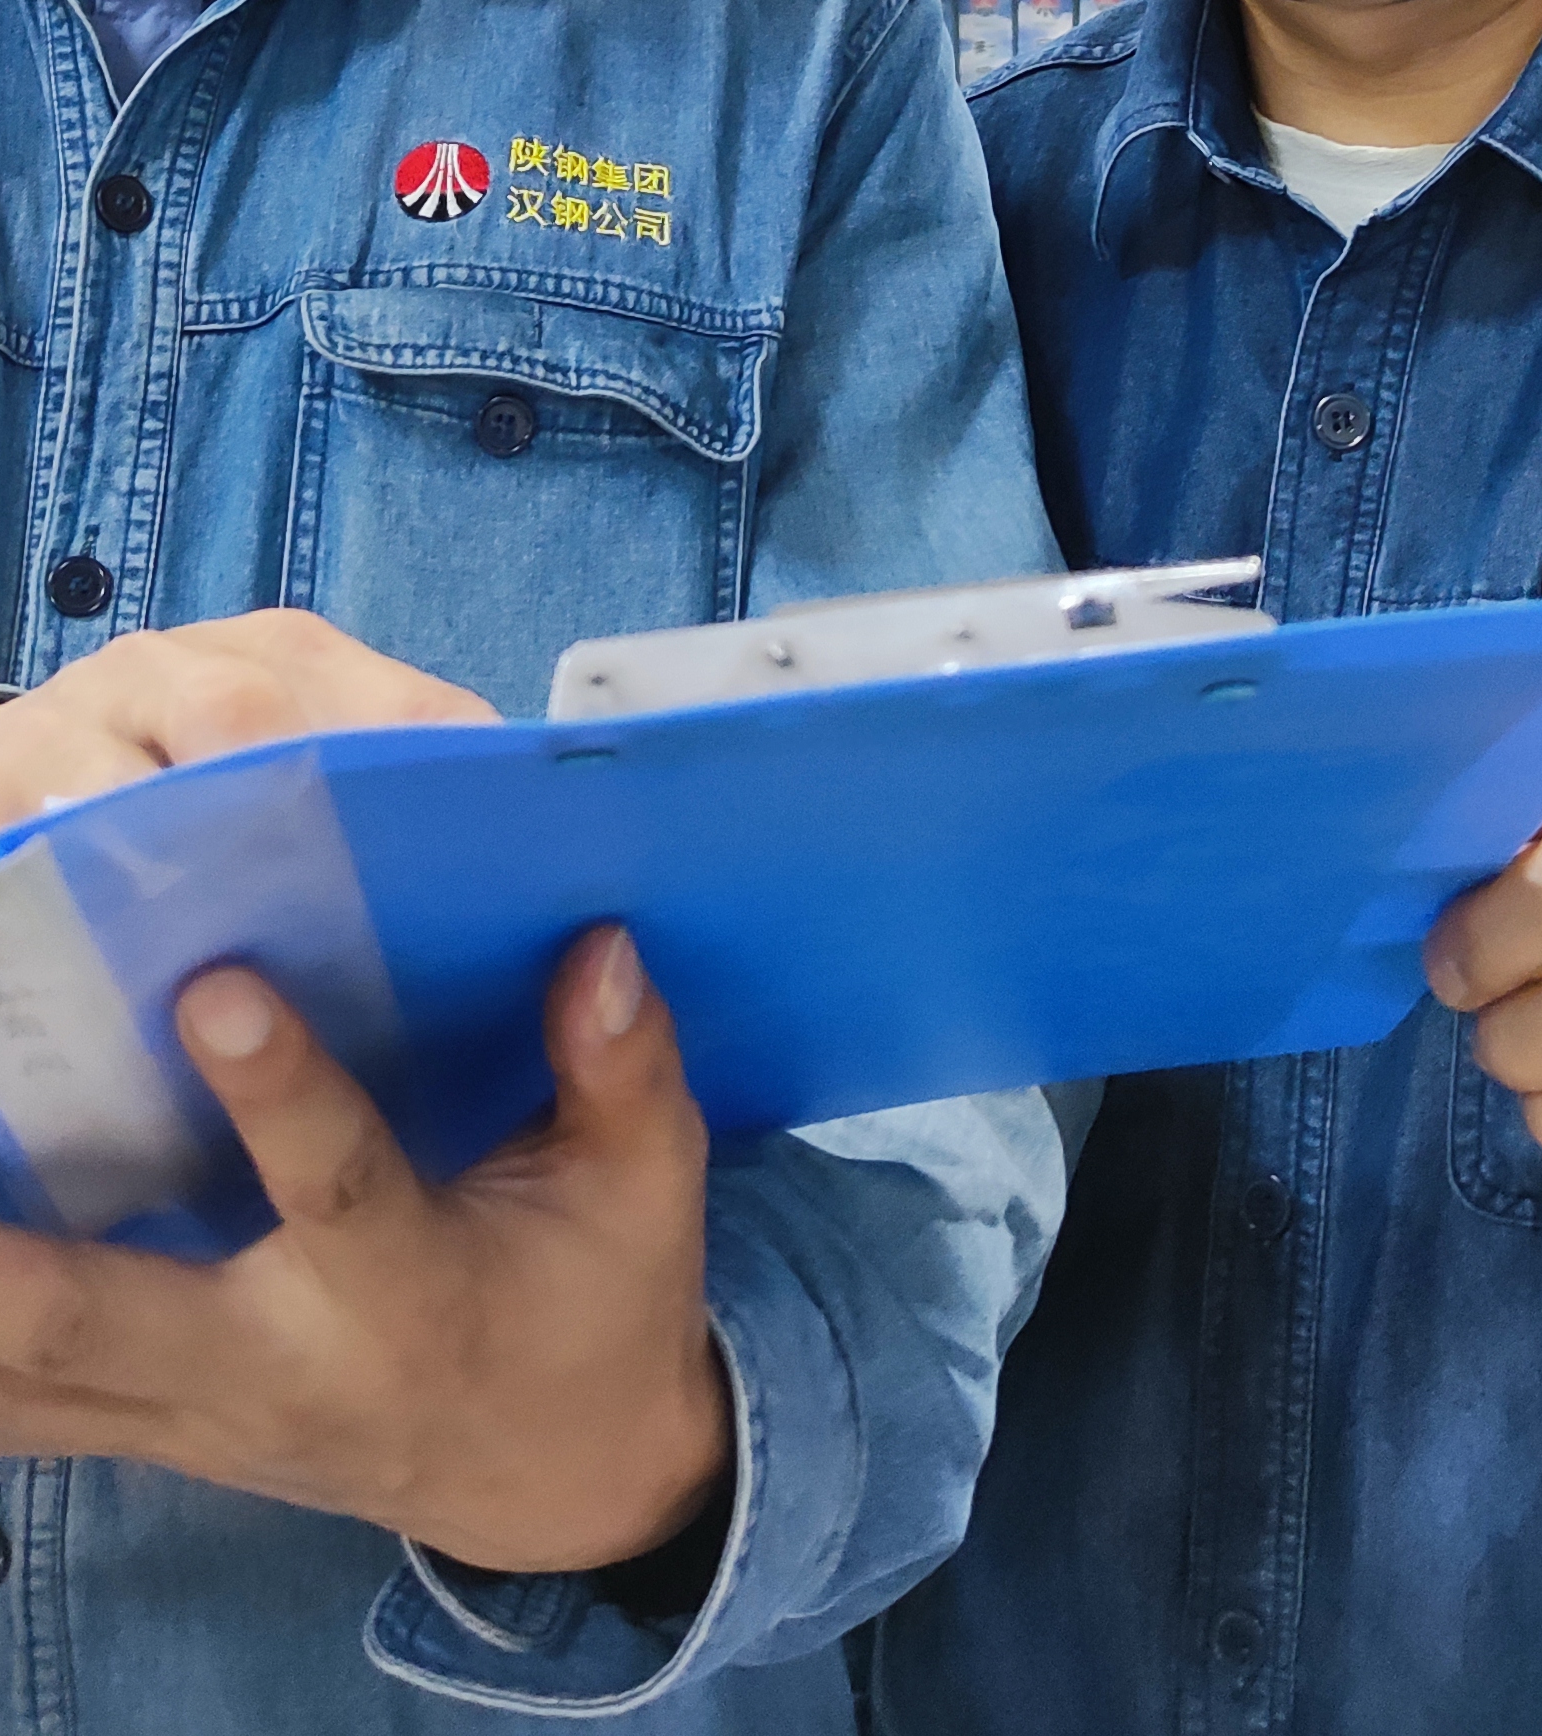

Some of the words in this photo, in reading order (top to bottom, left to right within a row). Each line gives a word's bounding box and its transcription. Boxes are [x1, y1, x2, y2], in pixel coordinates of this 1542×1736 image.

[508, 136, 671, 198] 陕钢集团
[506, 185, 672, 247] 汉钢公司
